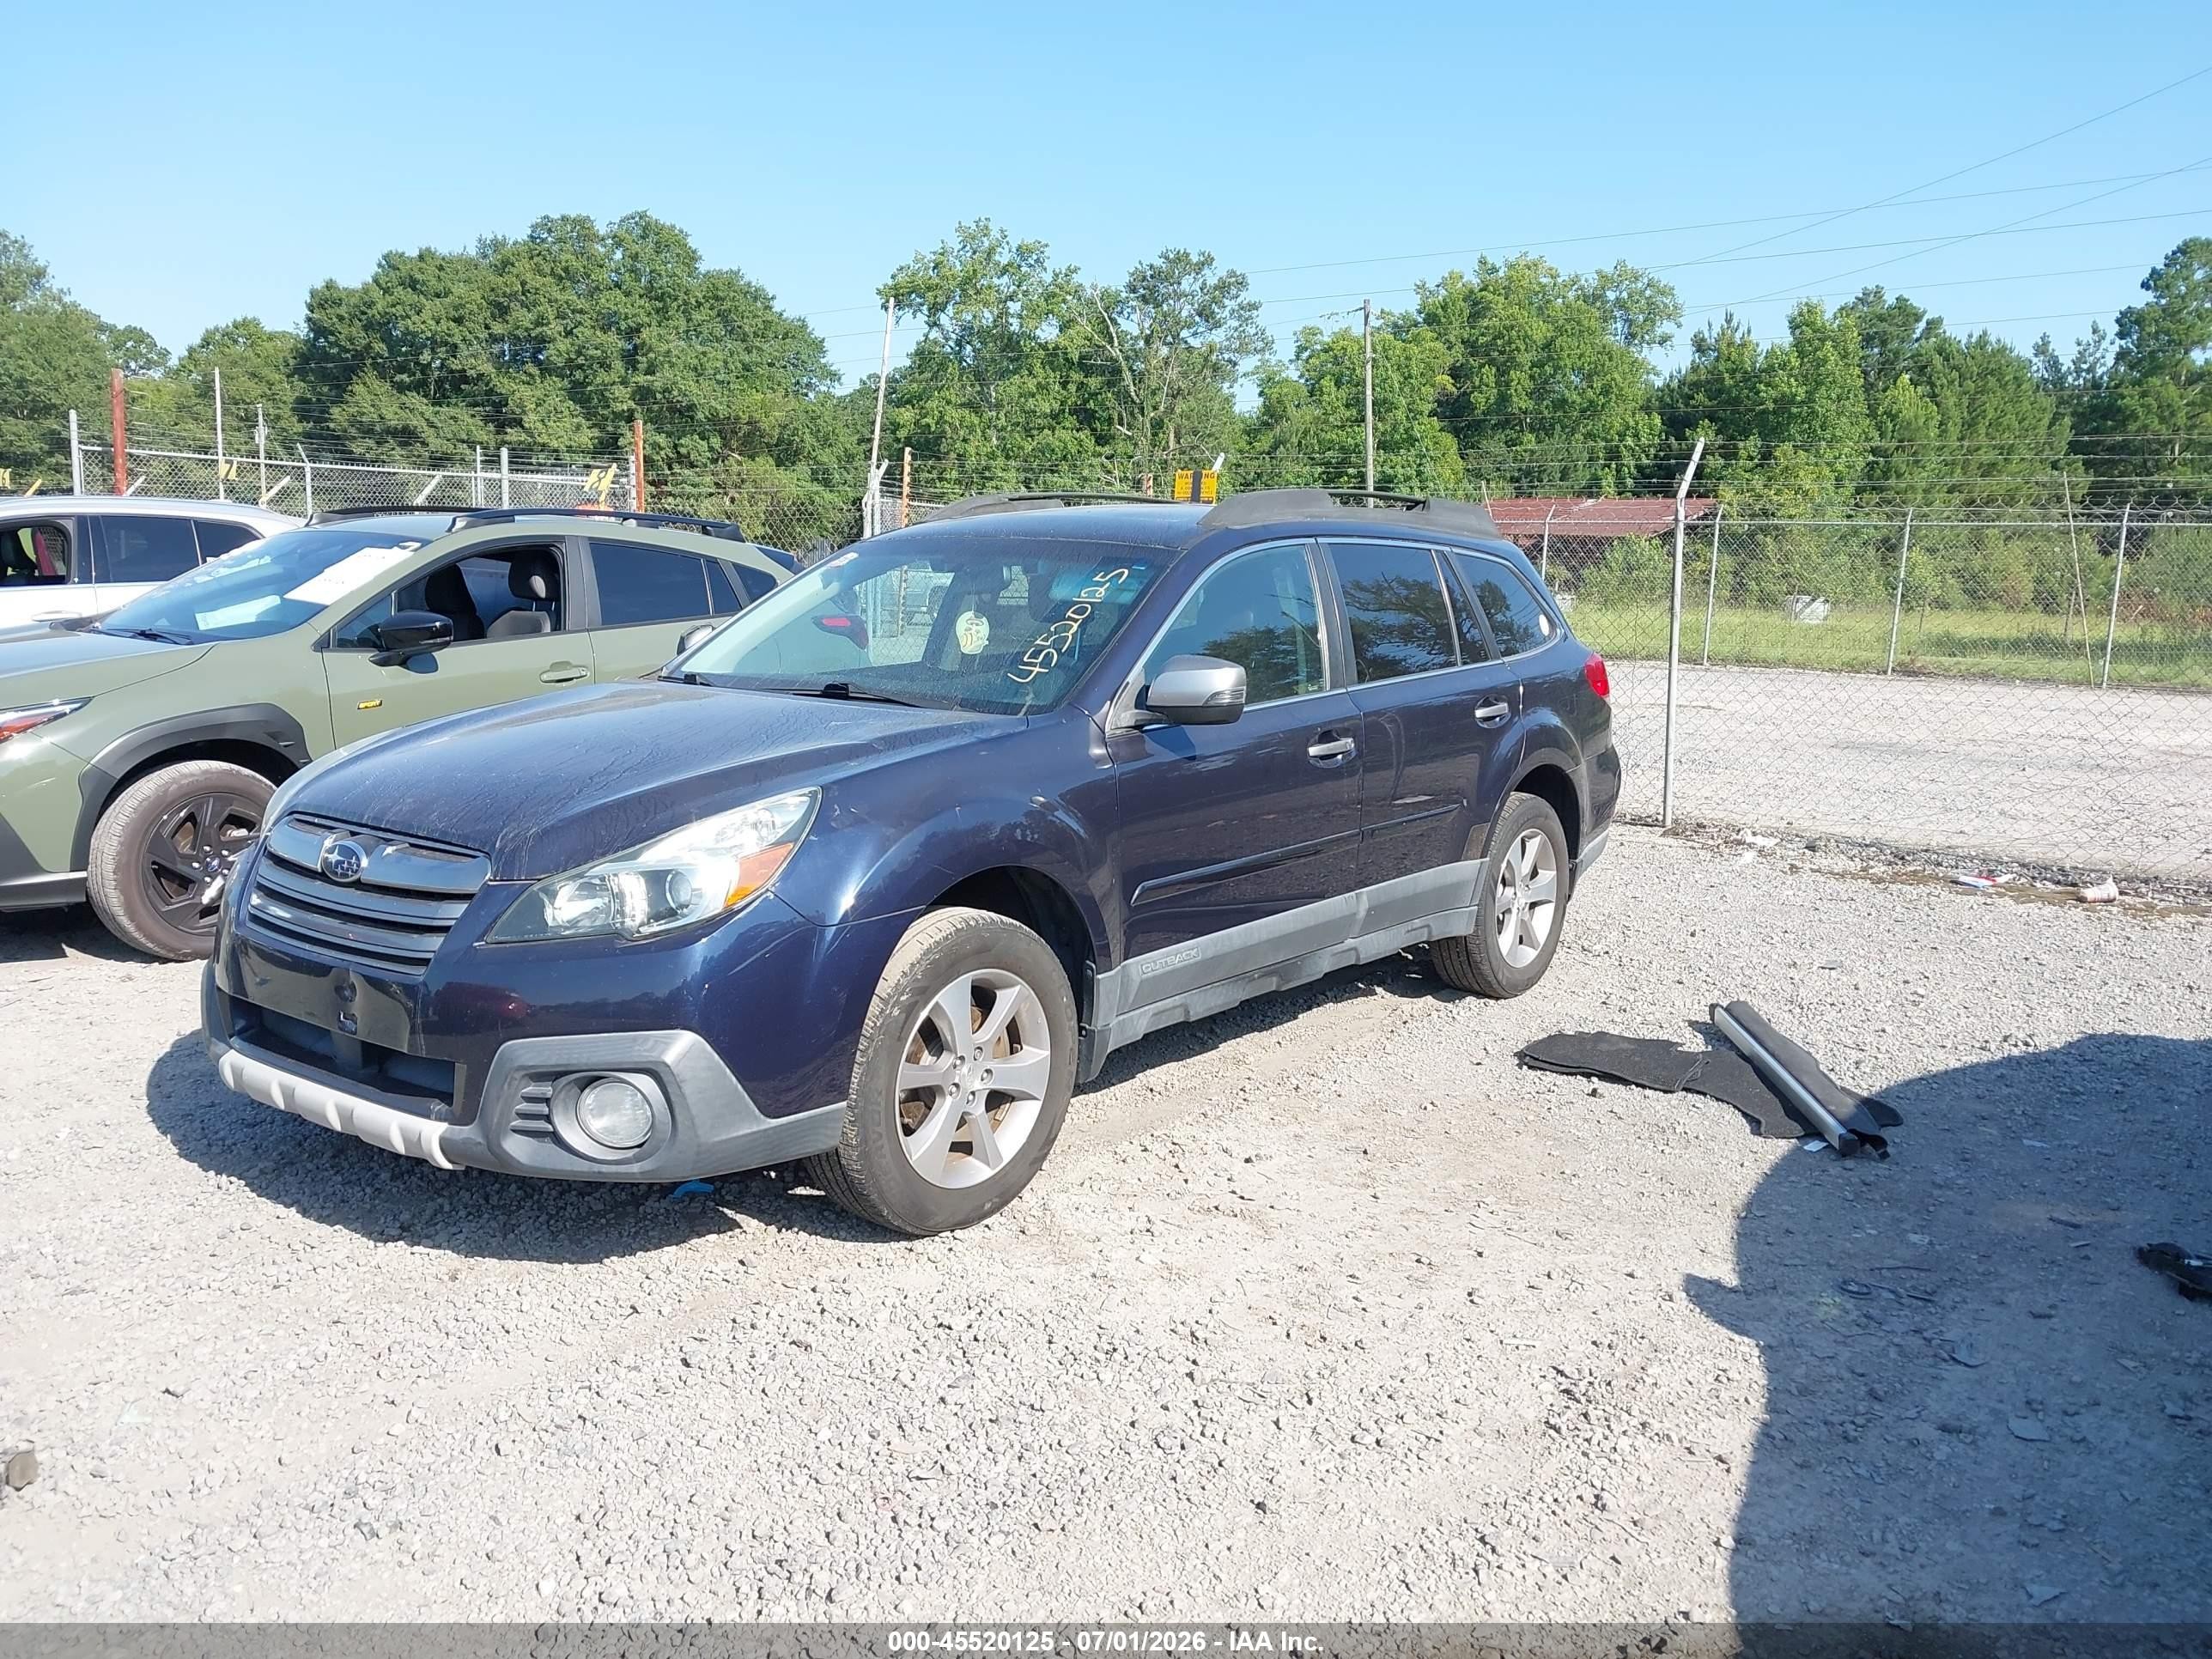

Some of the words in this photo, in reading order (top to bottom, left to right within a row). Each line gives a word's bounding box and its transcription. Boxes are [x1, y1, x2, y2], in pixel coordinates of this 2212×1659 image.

[222, 459, 234, 480] 7
[589, 468, 609, 490] 8
[1006, 568, 1129, 684] 45520125
[1142, 948, 1198, 973] OUTBACK
